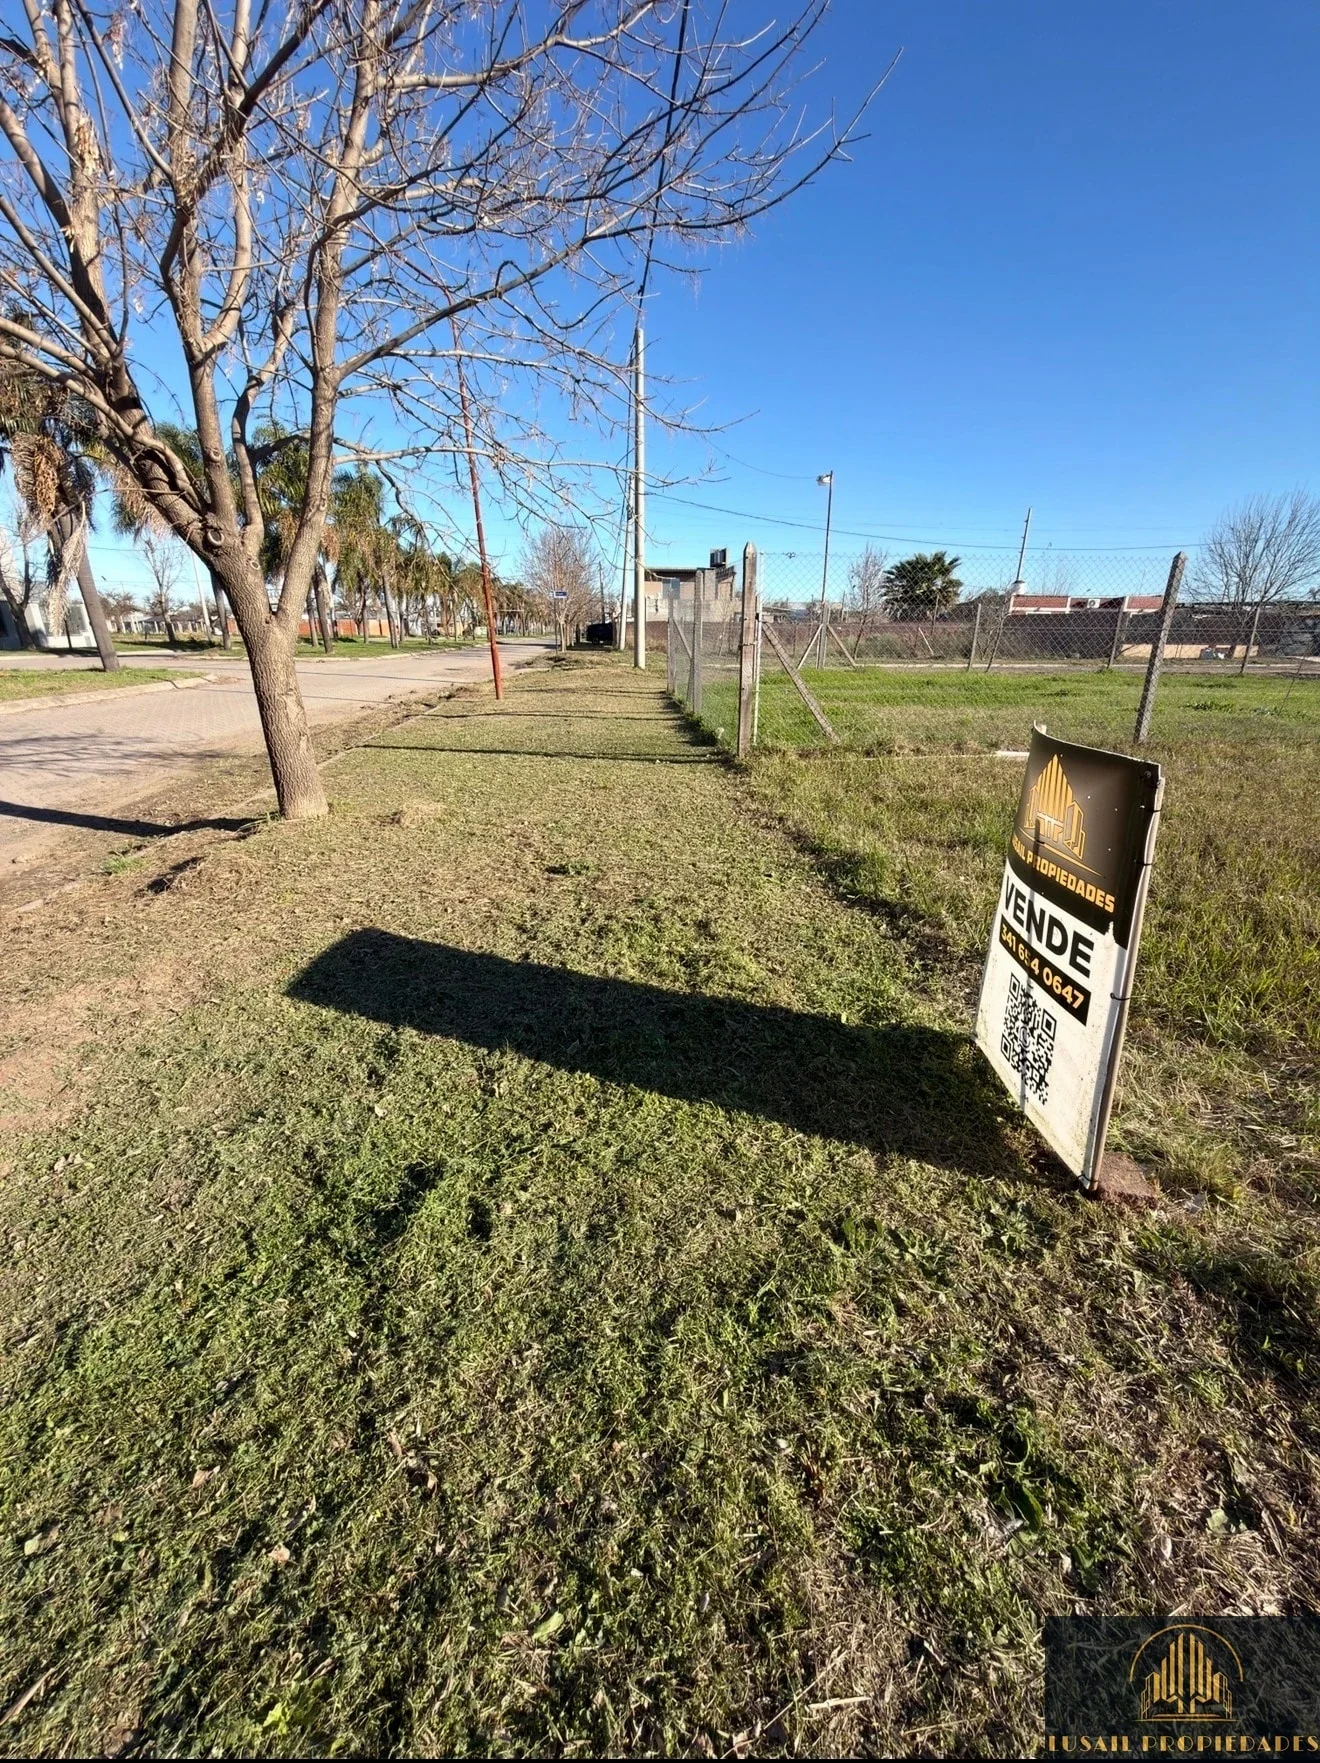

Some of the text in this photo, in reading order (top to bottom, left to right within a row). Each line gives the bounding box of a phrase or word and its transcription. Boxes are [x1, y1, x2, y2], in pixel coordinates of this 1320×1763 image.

[1026, 850, 1115, 913] PROPIEDADES
[1001, 923, 1016, 952] 341
[1042, 966, 1085, 1009] 0647
[1005, 874, 1095, 979] VENDE
